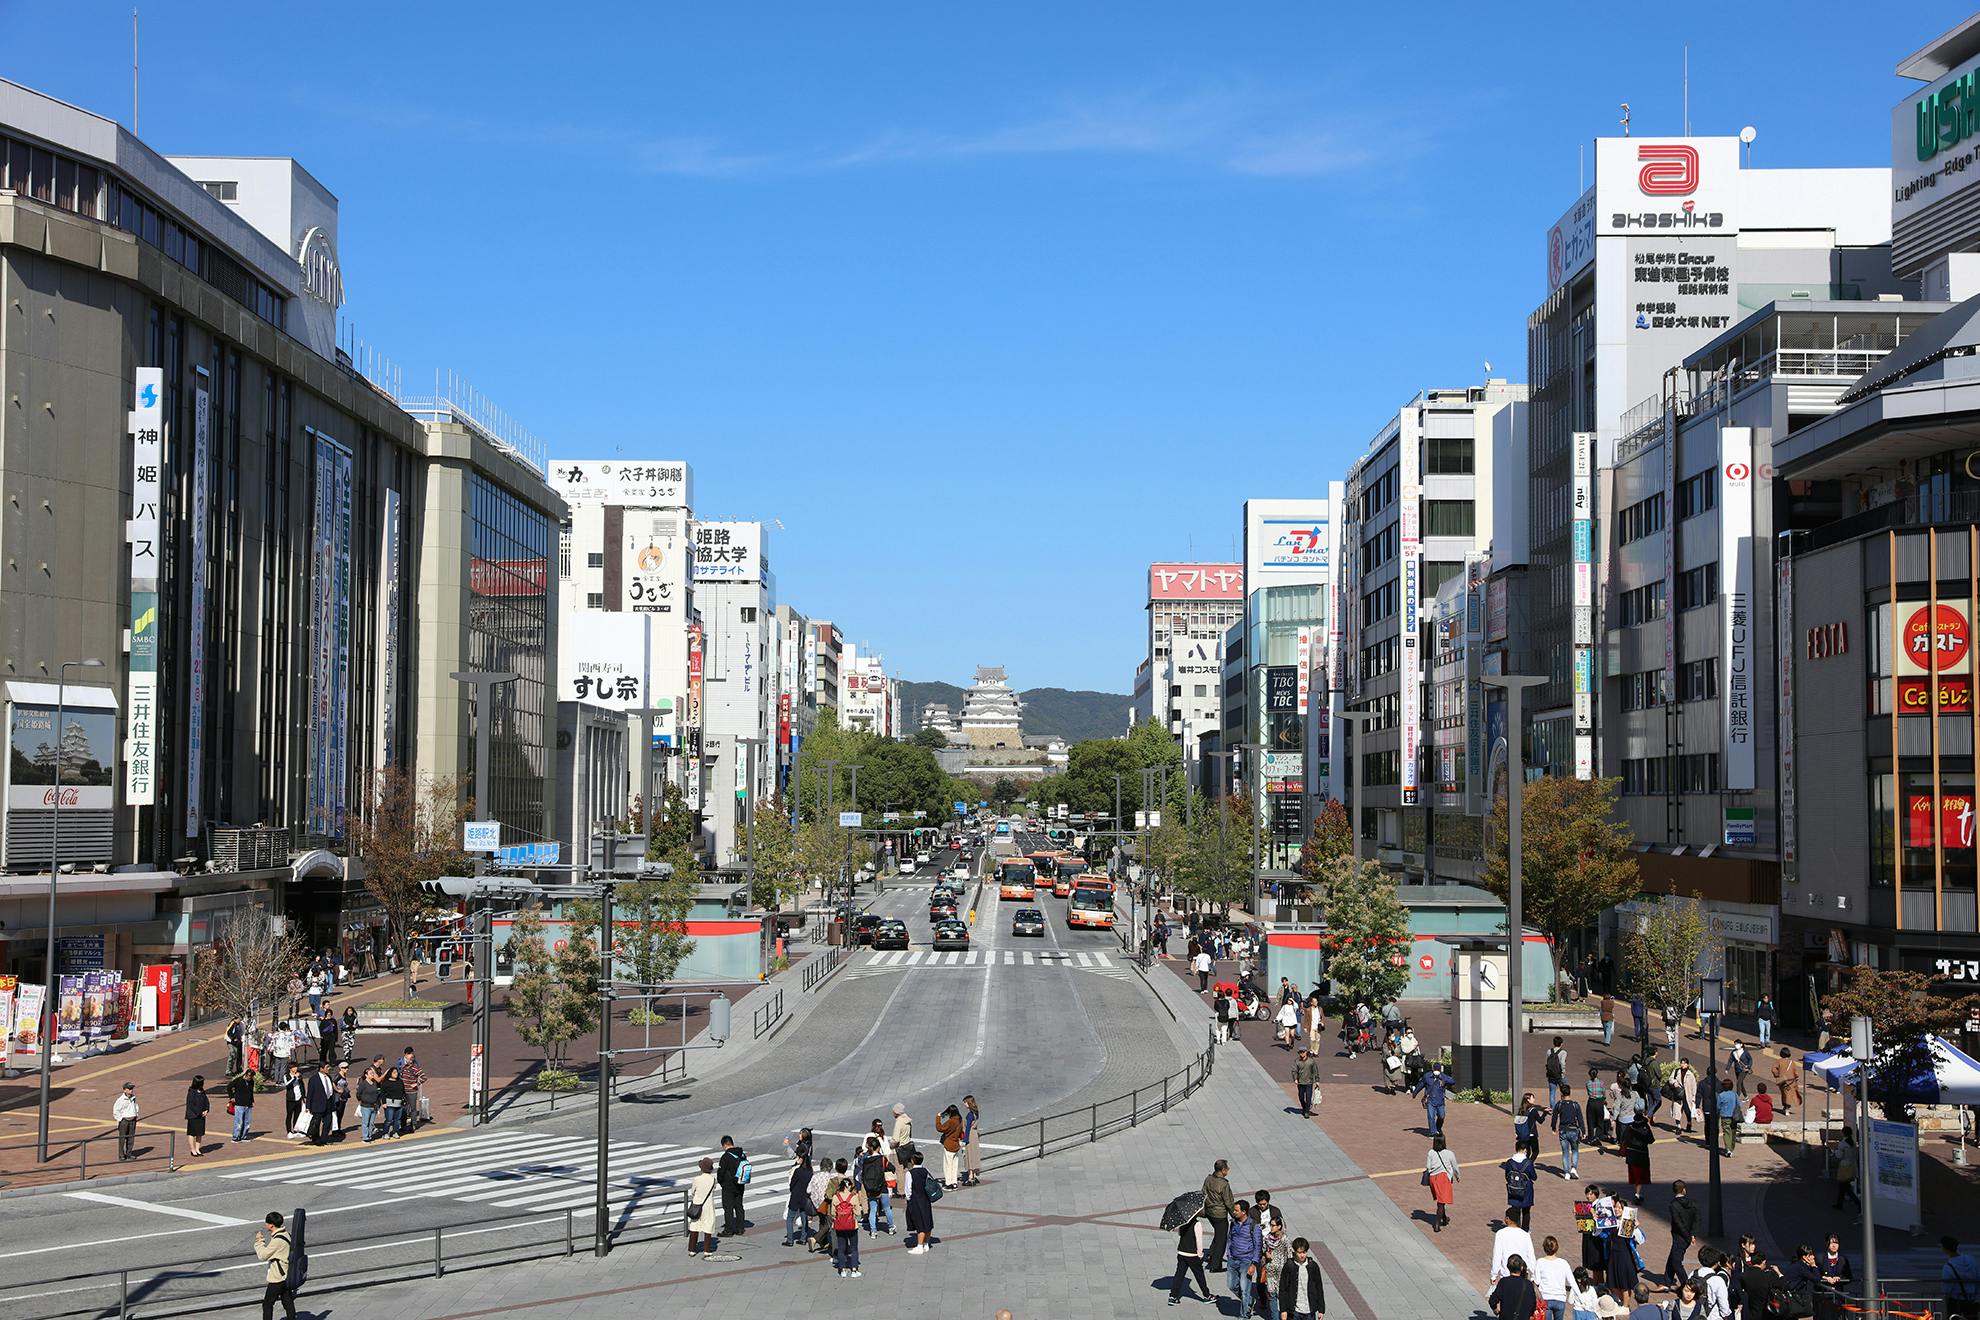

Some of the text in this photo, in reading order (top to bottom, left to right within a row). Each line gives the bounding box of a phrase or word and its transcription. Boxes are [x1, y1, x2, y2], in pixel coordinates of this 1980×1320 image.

[1612, 206, 1723, 228] akashika
[1635, 253, 1676, 265] 松尾学院
[1634, 267, 1729, 282] 東進衛星予備校
[1678, 283, 1728, 295] 姫路駅前校
[1636, 302, 1676, 314] 中学受験
[1652, 316, 1730, 328] 四谷大塚 NET
[619, 467, 682, 482] 穴子丼御膳
[136, 428, 158, 558] 神姫バス
[696, 529, 730, 545] 姫路
[629, 577, 674, 602] うさぎ
[1407, 561, 1415, 632] 個別教室のトライ
[132, 635, 155, 643] SMBC
[1807, 621, 1848, 660] FESTA
[579, 663, 623, 673] 関西寿司
[1730, 593, 1749, 744] 三菱UFJ信託銀行
[573, 675, 639, 701] すし宗
[1272, 676, 1294, 688] TBC
[1273, 695, 1294, 707] TBC
[131, 685, 151, 794] 三井住友銀行
